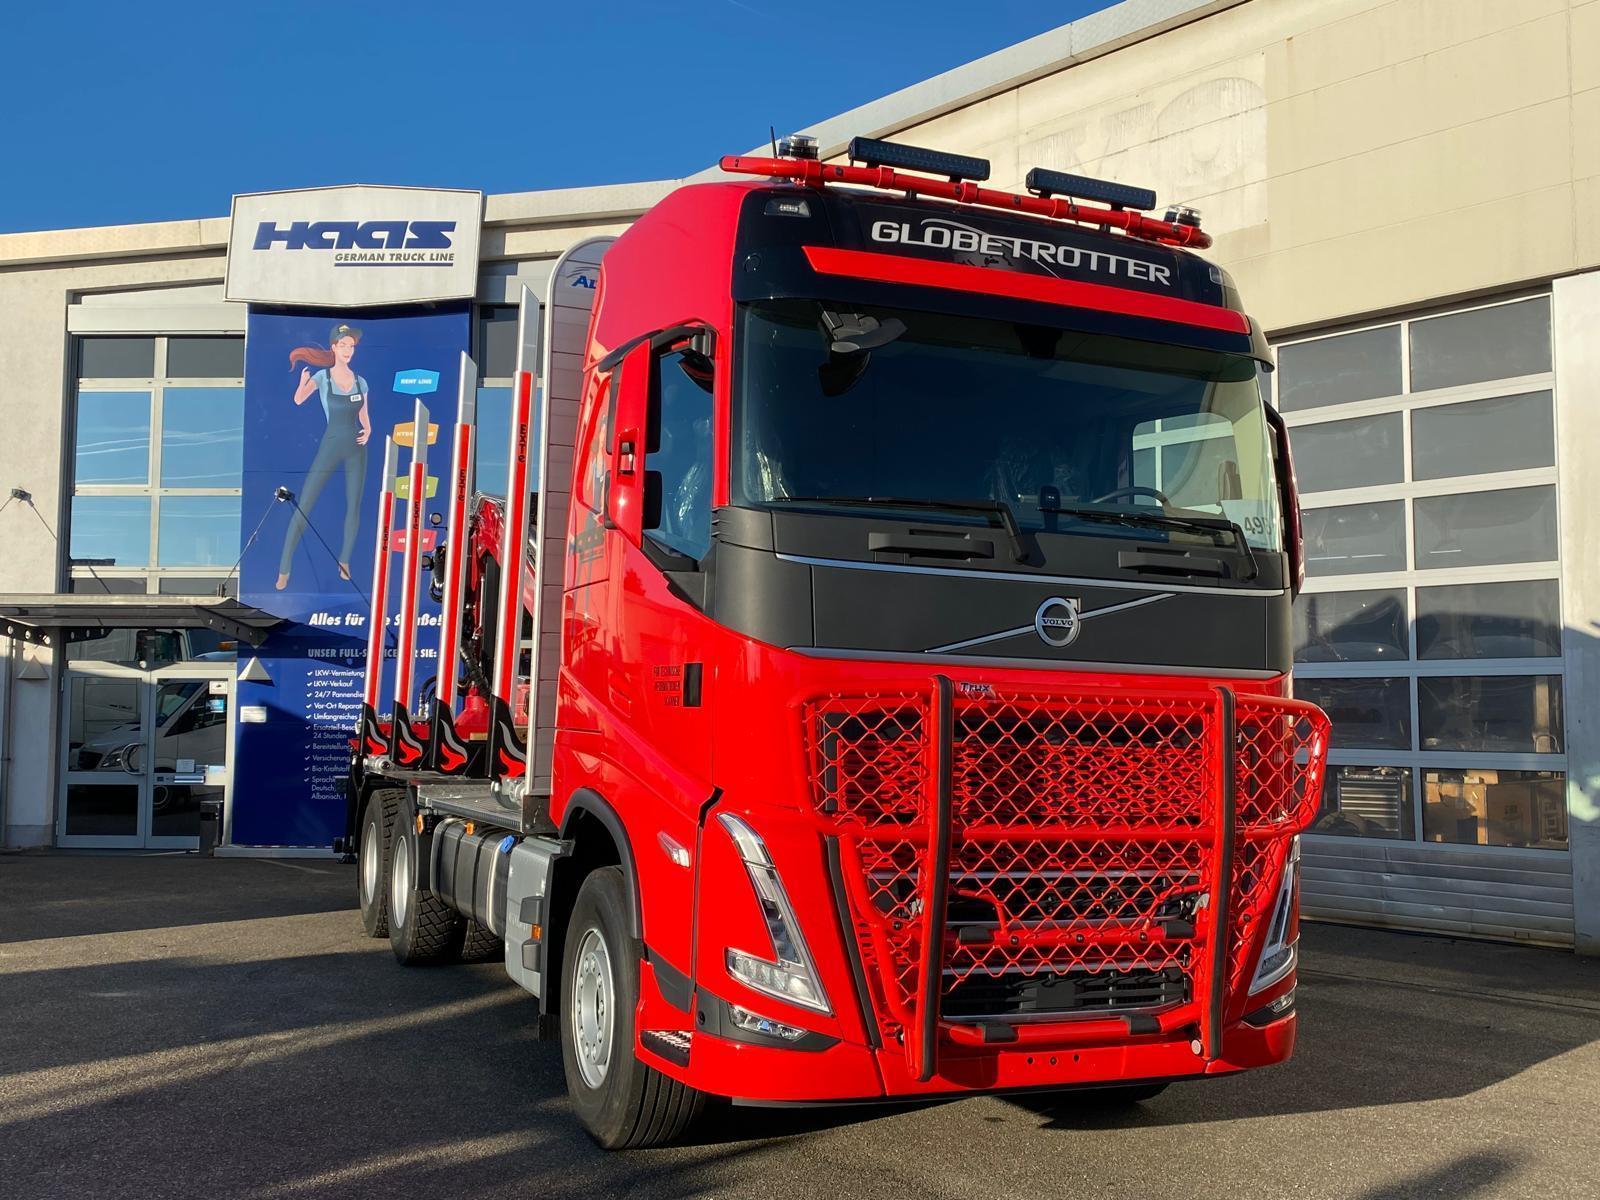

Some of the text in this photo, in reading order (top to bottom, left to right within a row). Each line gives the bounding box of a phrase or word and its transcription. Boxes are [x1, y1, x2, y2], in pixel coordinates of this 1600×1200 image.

[335, 253, 454, 262] GERMAN TRUCK LINE
[871, 220, 1171, 287] GLOBETROTTER
[308, 613, 342, 626] Alles
[344, 613, 366, 626] für
[308, 649, 337, 658] UNSER
[420, 649, 438, 658] SIE:
[315, 670, 365, 679] LKW-Vermietung
[313, 712, 358, 721] Umfangreiches
